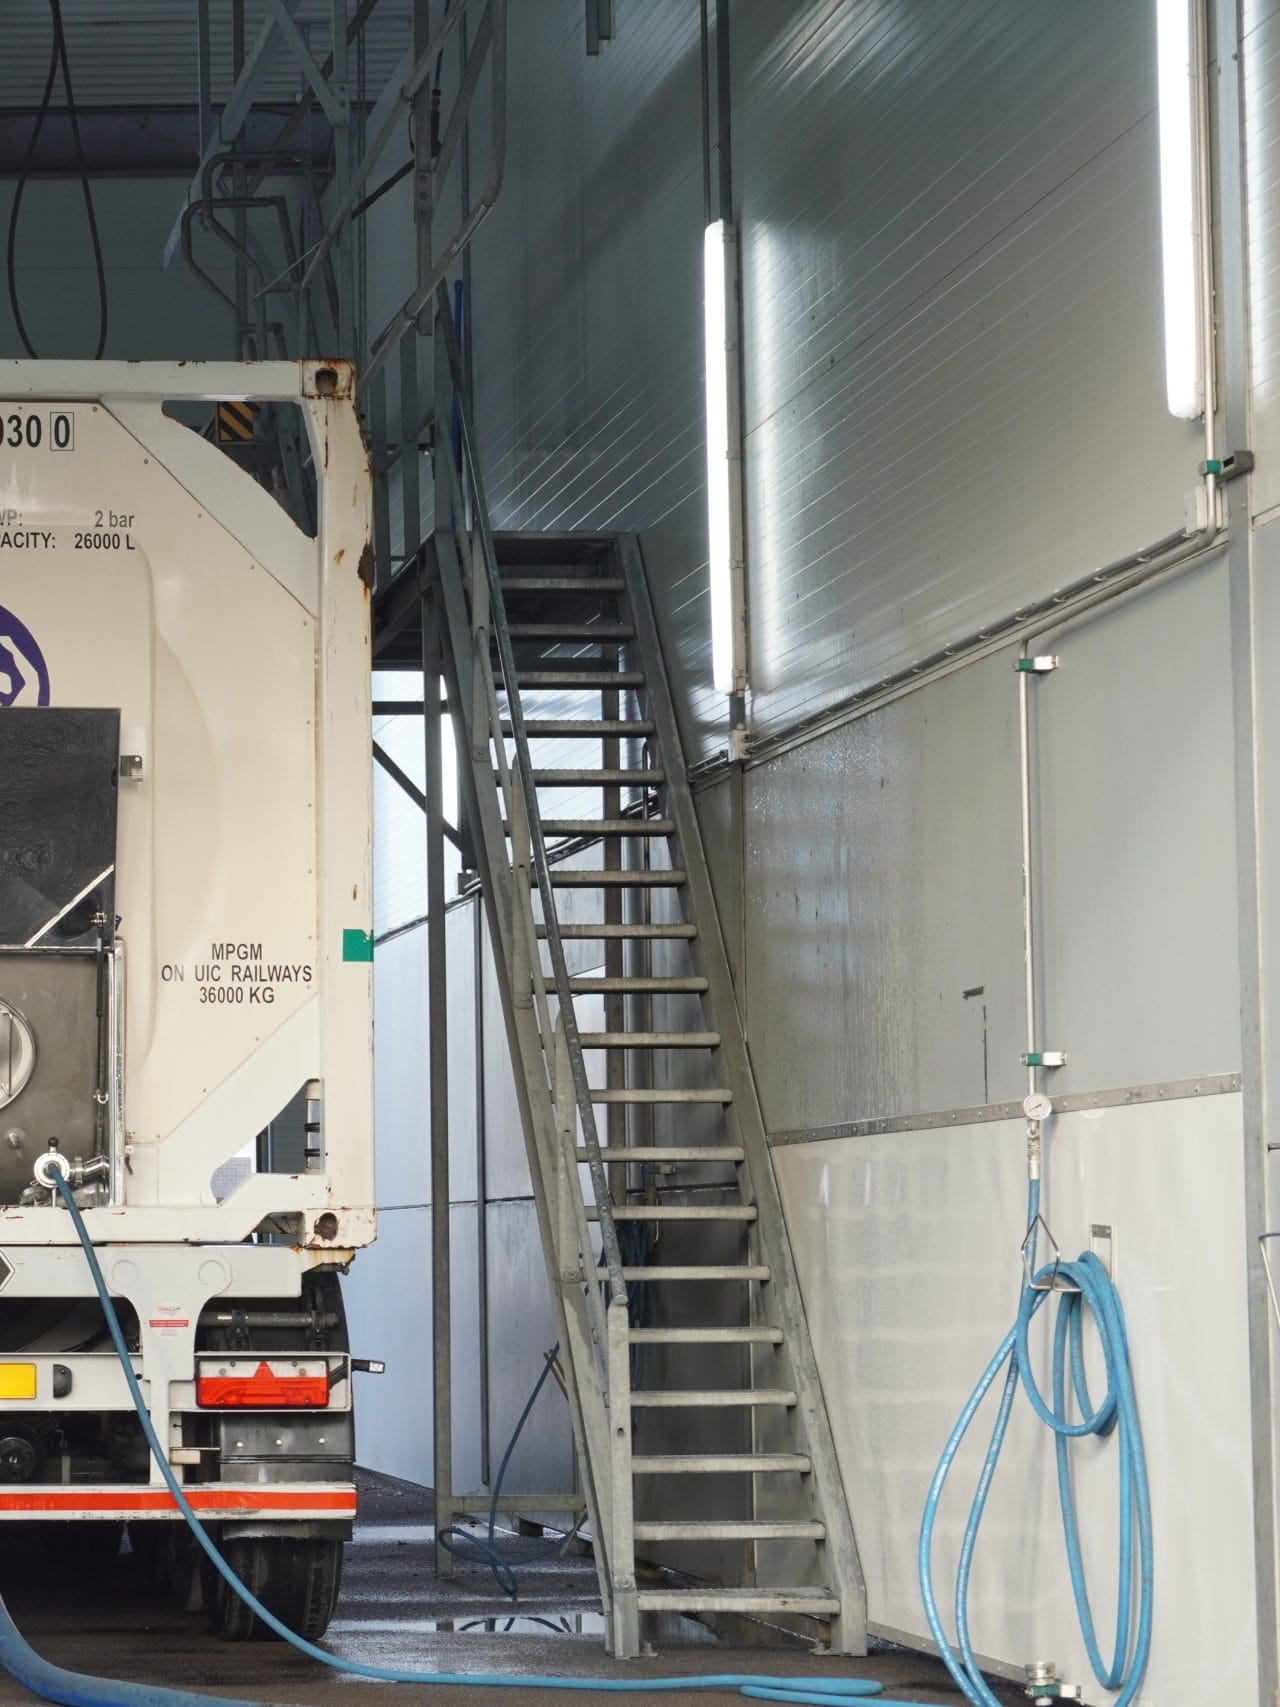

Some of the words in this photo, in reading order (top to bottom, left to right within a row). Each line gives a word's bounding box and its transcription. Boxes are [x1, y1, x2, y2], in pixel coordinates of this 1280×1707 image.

[52, 413, 73, 450] 0
[94, 510, 104, 528] 2
[108, 509, 135, 528] bar
[74, 532, 121, 550] 26000
[125, 533, 136, 550] L
[211, 943, 263, 961] MPGM
[161, 965, 184, 982] ON
[194, 965, 222, 982] UIC
[231, 965, 313, 983] RAILWAYS
[199, 987, 244, 1004] 36000
[249, 987, 275, 1004] KG
